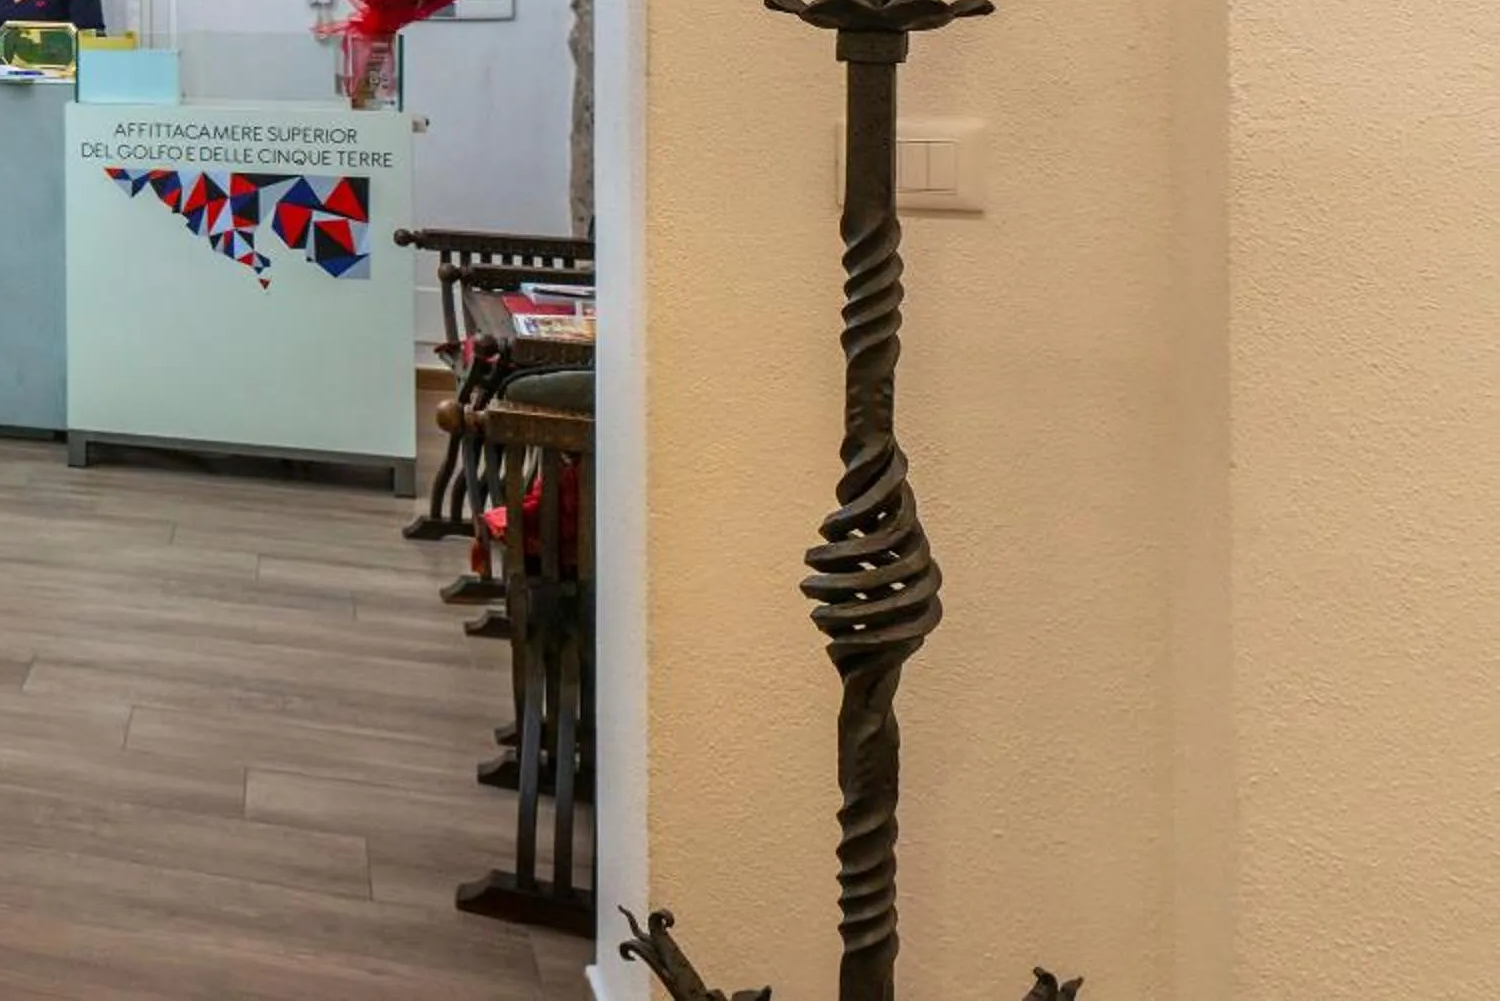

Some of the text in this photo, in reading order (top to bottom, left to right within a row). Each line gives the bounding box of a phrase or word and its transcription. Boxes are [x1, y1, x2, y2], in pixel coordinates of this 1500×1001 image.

[115, 122, 358, 144] AFFITTACAMERE SUPERIOR
[81, 142, 394, 168] DEL GOLFO E DELLE CINQUE TERRE
